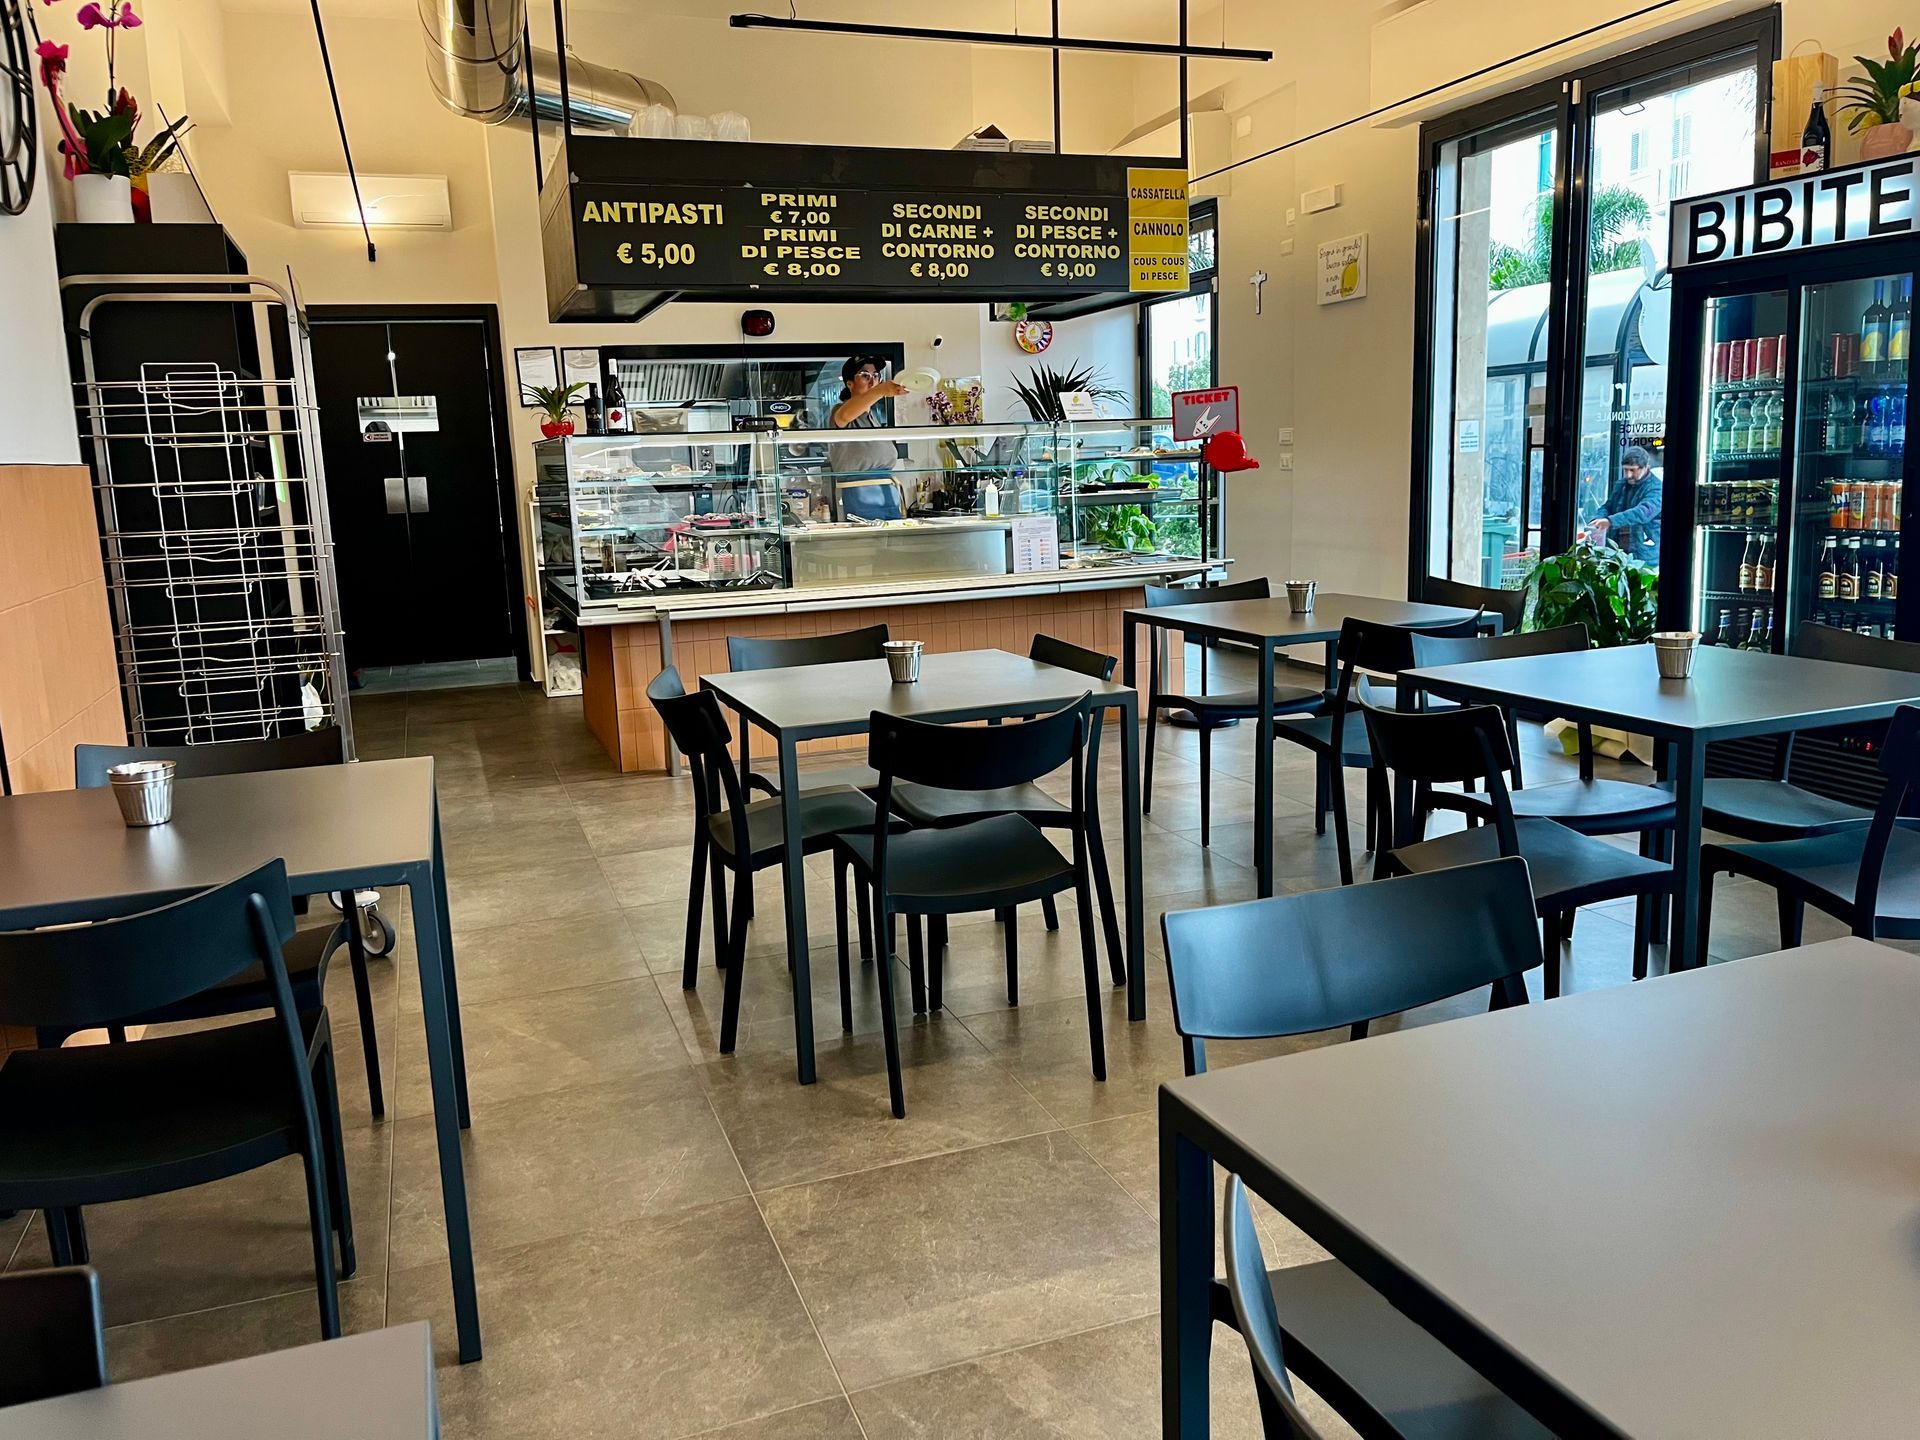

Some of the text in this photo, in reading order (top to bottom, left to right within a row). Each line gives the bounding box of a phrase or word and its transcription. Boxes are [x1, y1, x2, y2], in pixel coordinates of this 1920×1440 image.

[761, 193, 837, 208] PRIMI
[1130, 187, 1186, 201] CASSATELLA
[582, 201, 724, 225] ANTIPASTI
[769, 210, 831, 227] € 7,00
[892, 203, 982, 220] SECONDI
[1025, 205, 1109, 222] SECONDI
[1687, 161, 1914, 265] BIBITE
[763, 228, 837, 242] PRIMI
[881, 223, 994, 239] DI CARNE +
[1016, 224, 1118, 240] DI PESCE +
[1133, 222, 1184, 237] CANNOLO
[616, 242, 696, 270] € 5,00
[741, 245, 861, 260] DI PESCE
[881, 242, 995, 259] CONTORNO
[1014, 243, 1121, 259] CONTORNO
[1133, 257, 1185, 266] COUS COUS
[763, 262, 841, 279] € 8,00
[910, 262, 969, 281] € 8,00
[1040, 262, 1096, 280] € 9,00
[1140, 271, 1179, 281] DI PESCE
[1182, 391, 1230, 406] TICKET
